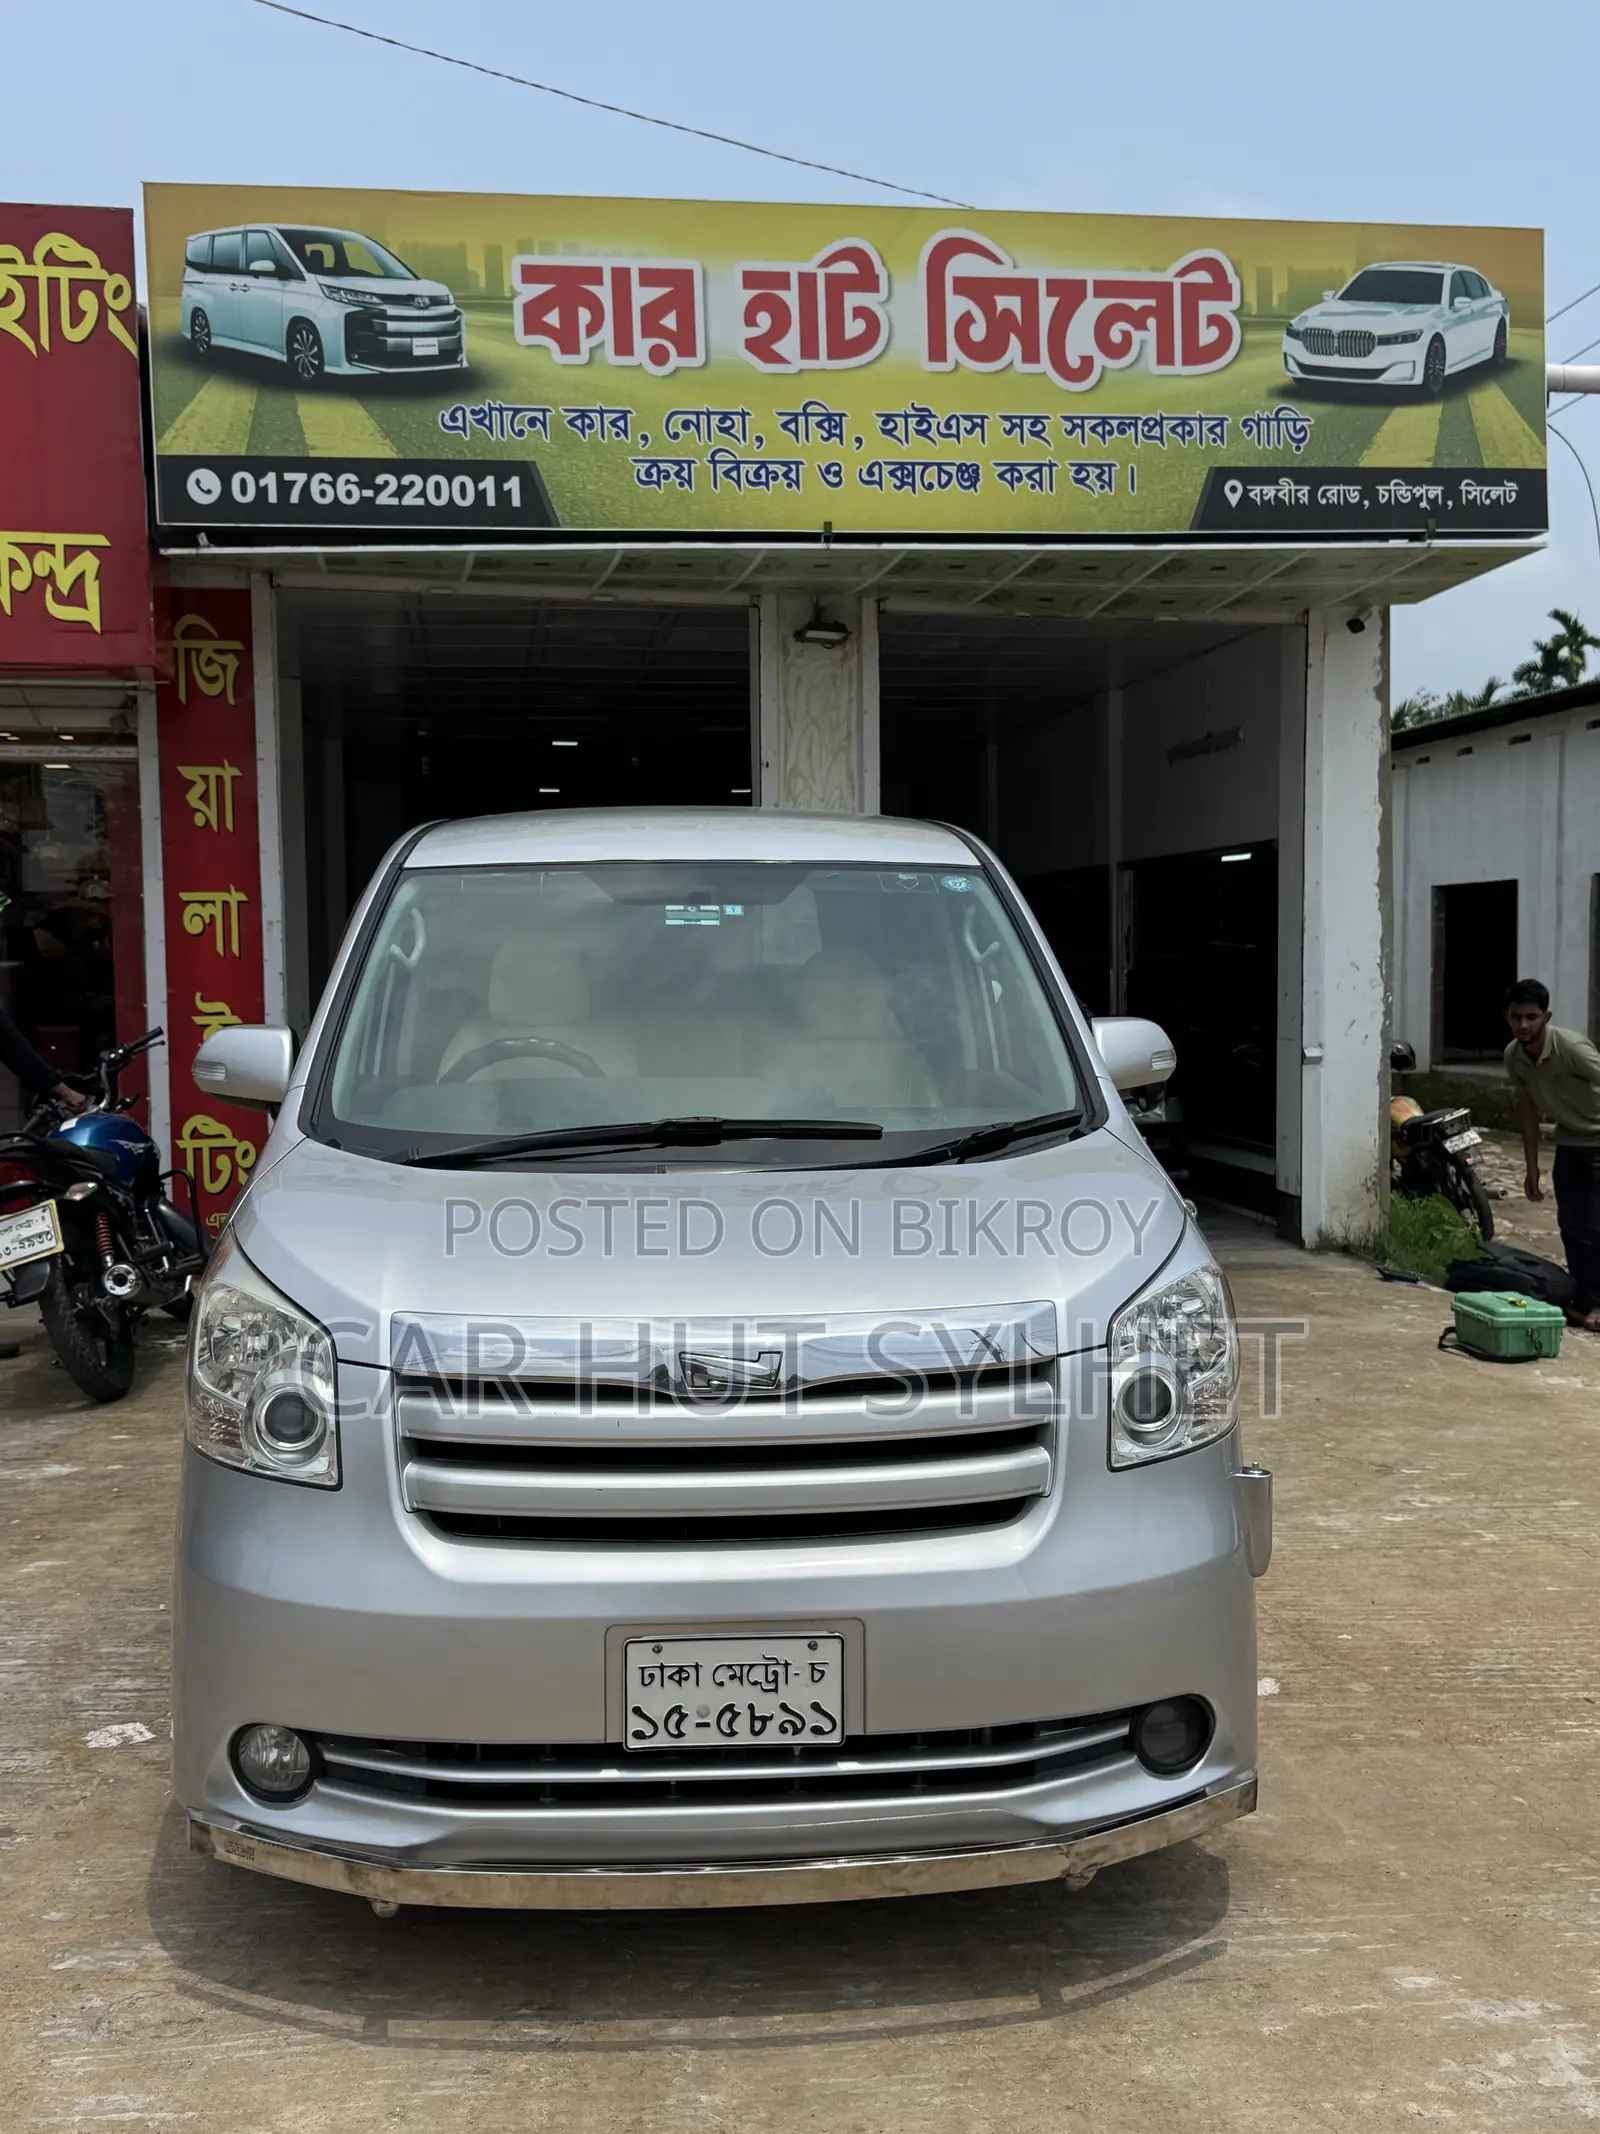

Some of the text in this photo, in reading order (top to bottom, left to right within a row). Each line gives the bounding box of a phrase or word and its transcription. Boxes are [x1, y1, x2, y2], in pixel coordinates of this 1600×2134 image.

[519, 235, 1235, 384] কার হাট সিলেট
[440, 401, 552, 440] এখানে
[876, 402, 989, 446] হাইএস
[1000, 415, 1051, 447] সহ
[1061, 411, 1229, 448] সকলপ্রকার
[1240, 405, 1311, 453] গাড়ি
[230, 471, 522, 508] 01766-220011
[631, 457, 697, 492] ক্রয়
[708, 448, 803, 493] বিক্রয়
[818, 461, 844, 488] ও
[859, 461, 980, 494] এক্সচেঞ্জ
[993, 460, 1058, 494] করা
[1246, 477, 1310, 506] বঙ্গবীর
[1459, 480, 1518, 505] সিলেট
[638, 1661, 703, 1688] ঢাকা
[631, 1701, 838, 1740] ১৫-৫৮৯১
